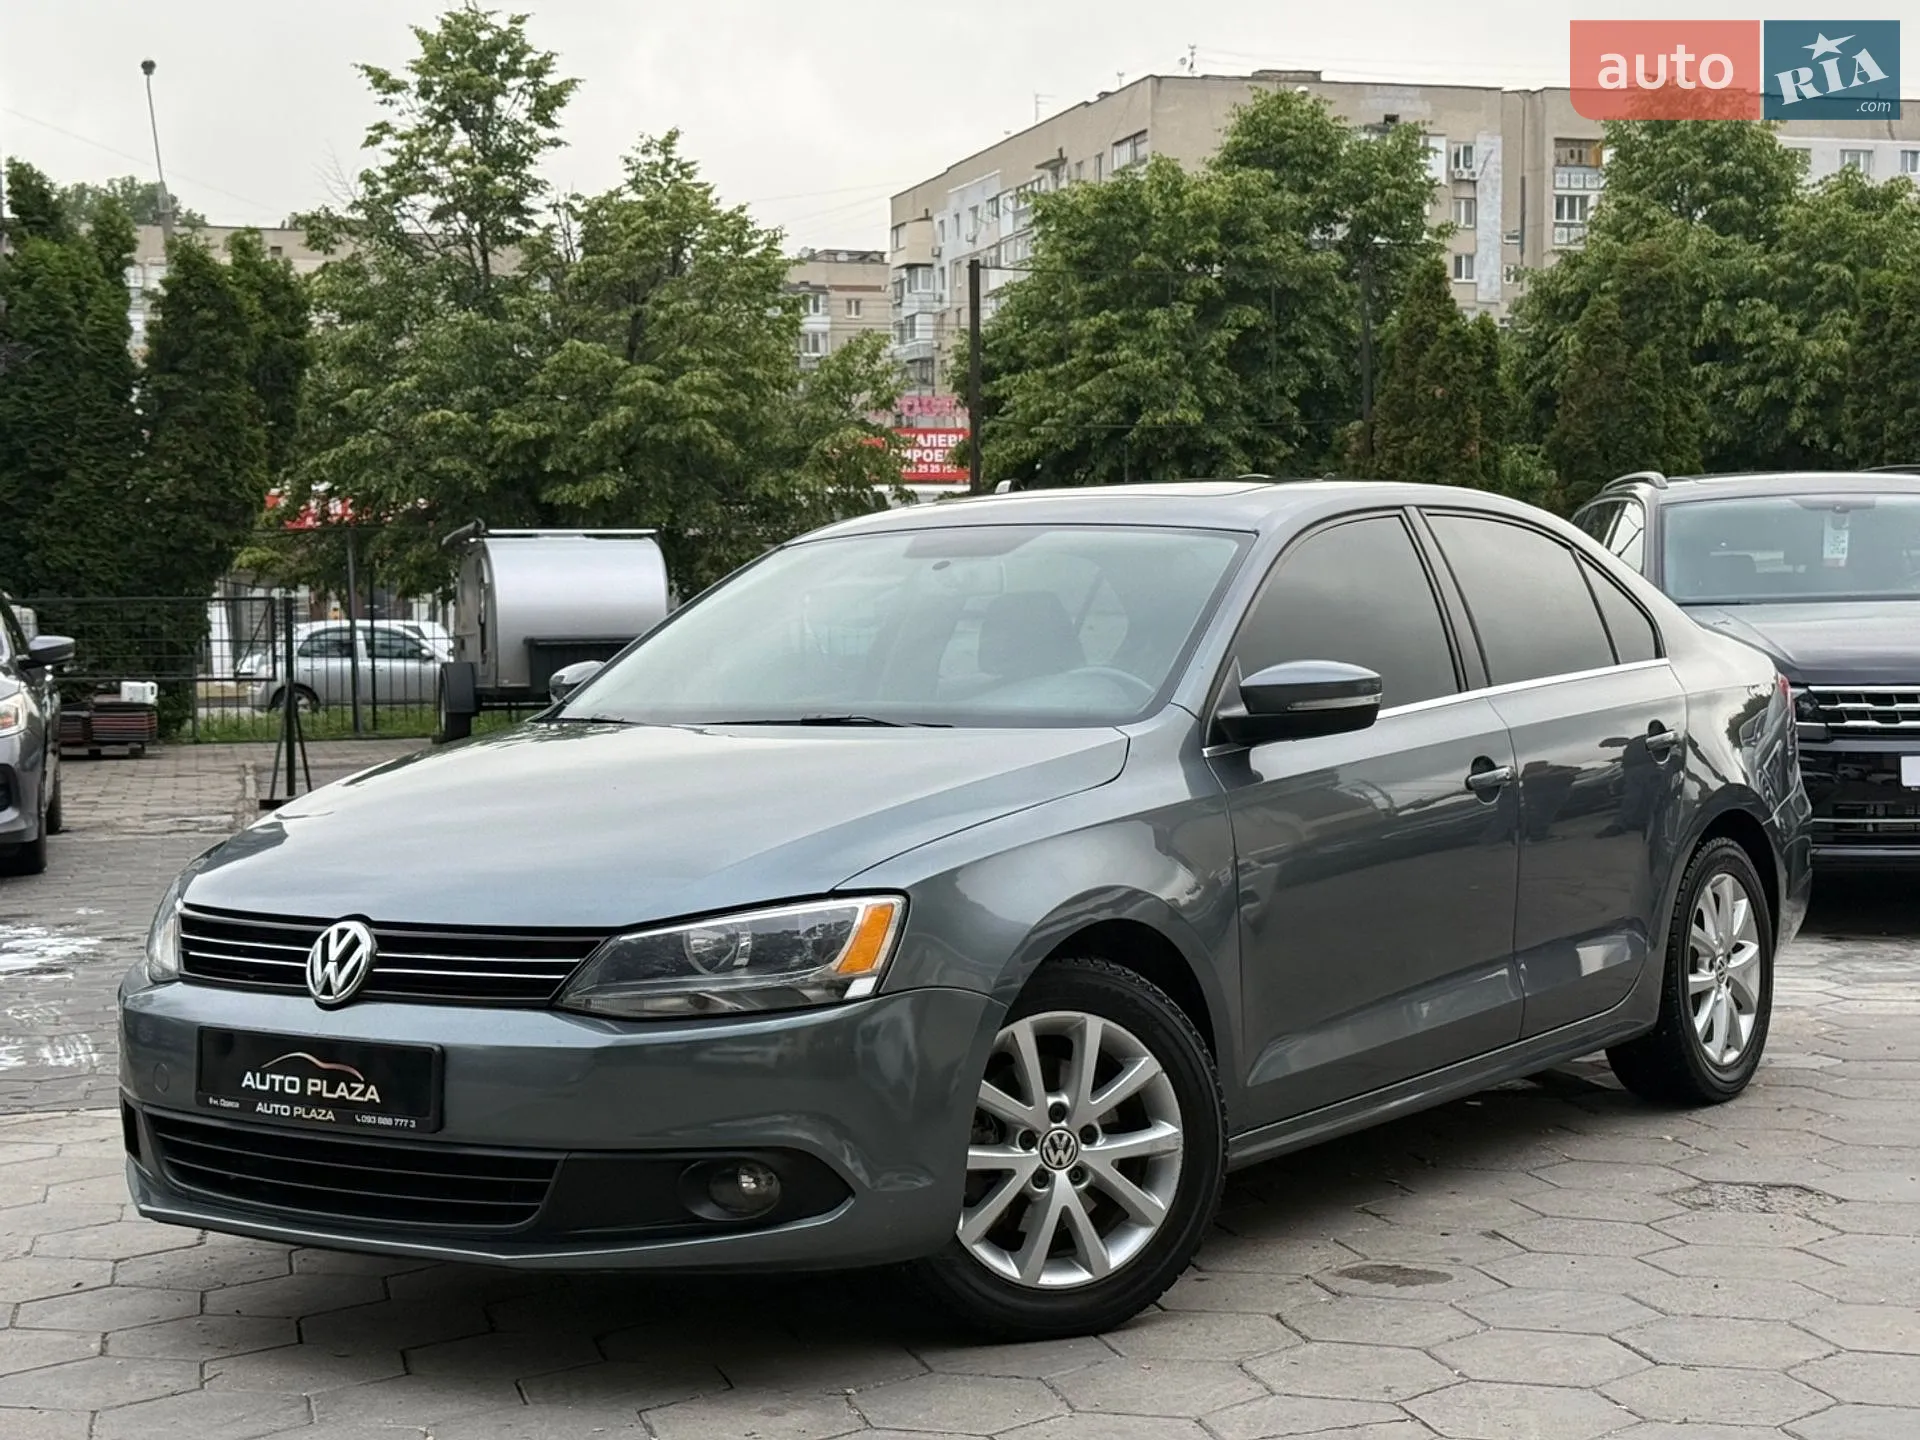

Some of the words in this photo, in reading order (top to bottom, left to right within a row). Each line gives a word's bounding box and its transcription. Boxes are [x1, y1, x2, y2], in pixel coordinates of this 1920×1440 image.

[241, 1071, 301, 1094] AUTO
[306, 1078, 381, 1103] PLAZA
[255, 1101, 291, 1117] AUTO
[293, 1105, 336, 1122] PLAZA
[394, 1118, 409, 1127] 777
